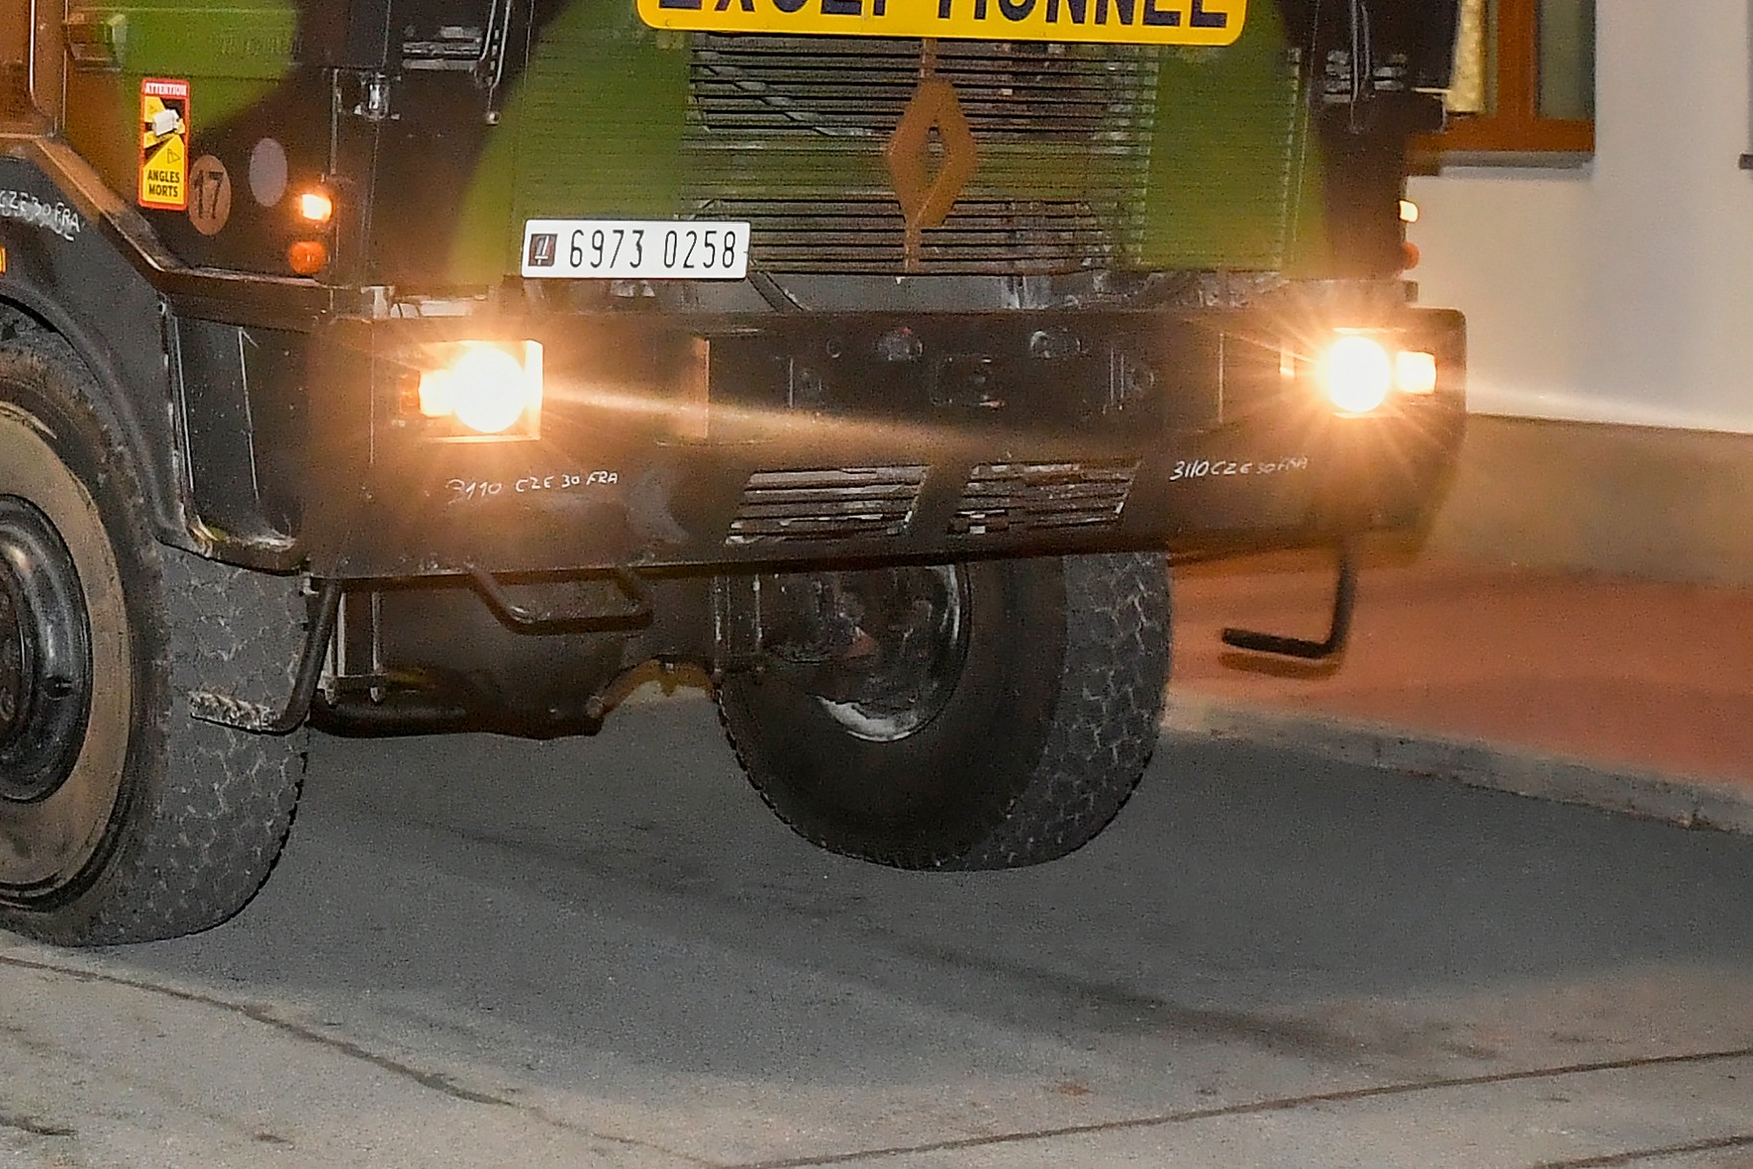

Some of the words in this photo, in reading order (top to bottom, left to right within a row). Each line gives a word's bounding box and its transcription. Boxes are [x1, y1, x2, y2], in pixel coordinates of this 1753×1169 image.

[145, 82, 188, 97] ATTENTION
[147, 169, 180, 184] ANGLES
[148, 184, 179, 198] MORTS
[194, 169, 224, 220] 17
[569, 229, 645, 269] 6973
[663, 230, 737, 269] 0258
[515, 476, 555, 493] CZE
